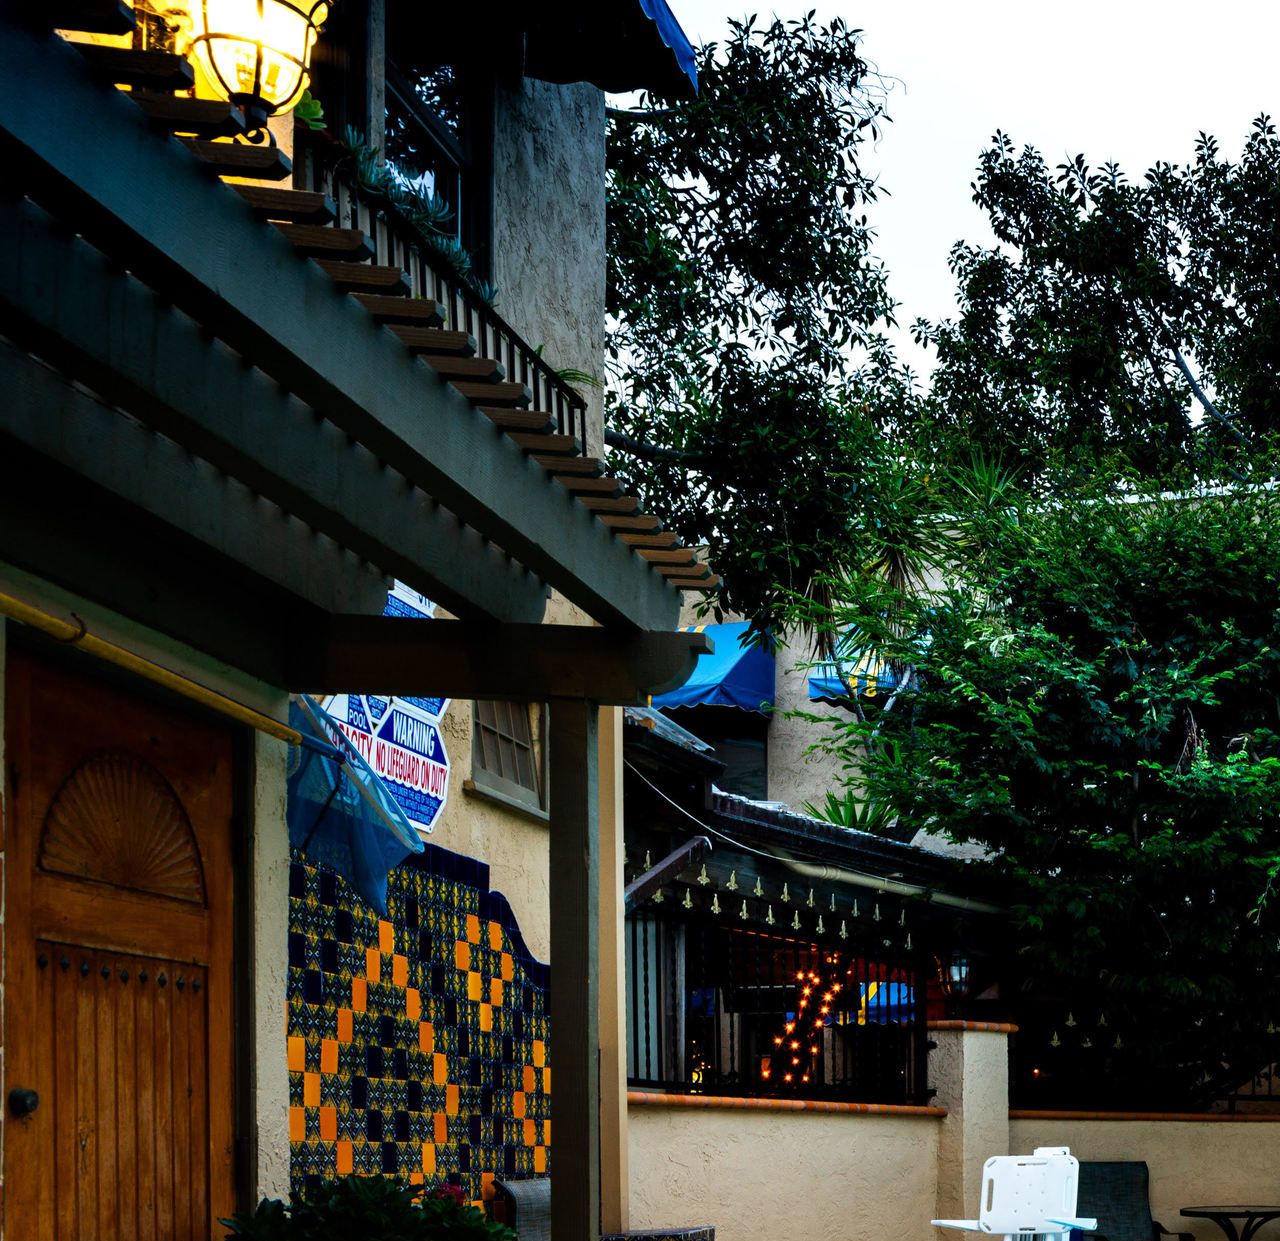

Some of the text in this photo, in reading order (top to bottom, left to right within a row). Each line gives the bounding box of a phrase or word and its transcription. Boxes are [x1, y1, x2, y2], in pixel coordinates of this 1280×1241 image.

[348, 709, 368, 730] POOL
[392, 709, 436, 757] WARNING
[375, 741, 386, 775] NO
[387, 745, 420, 787] LIFEGUARD
[420, 760, 431, 791] ON
[431, 764, 448, 797] DUTY
